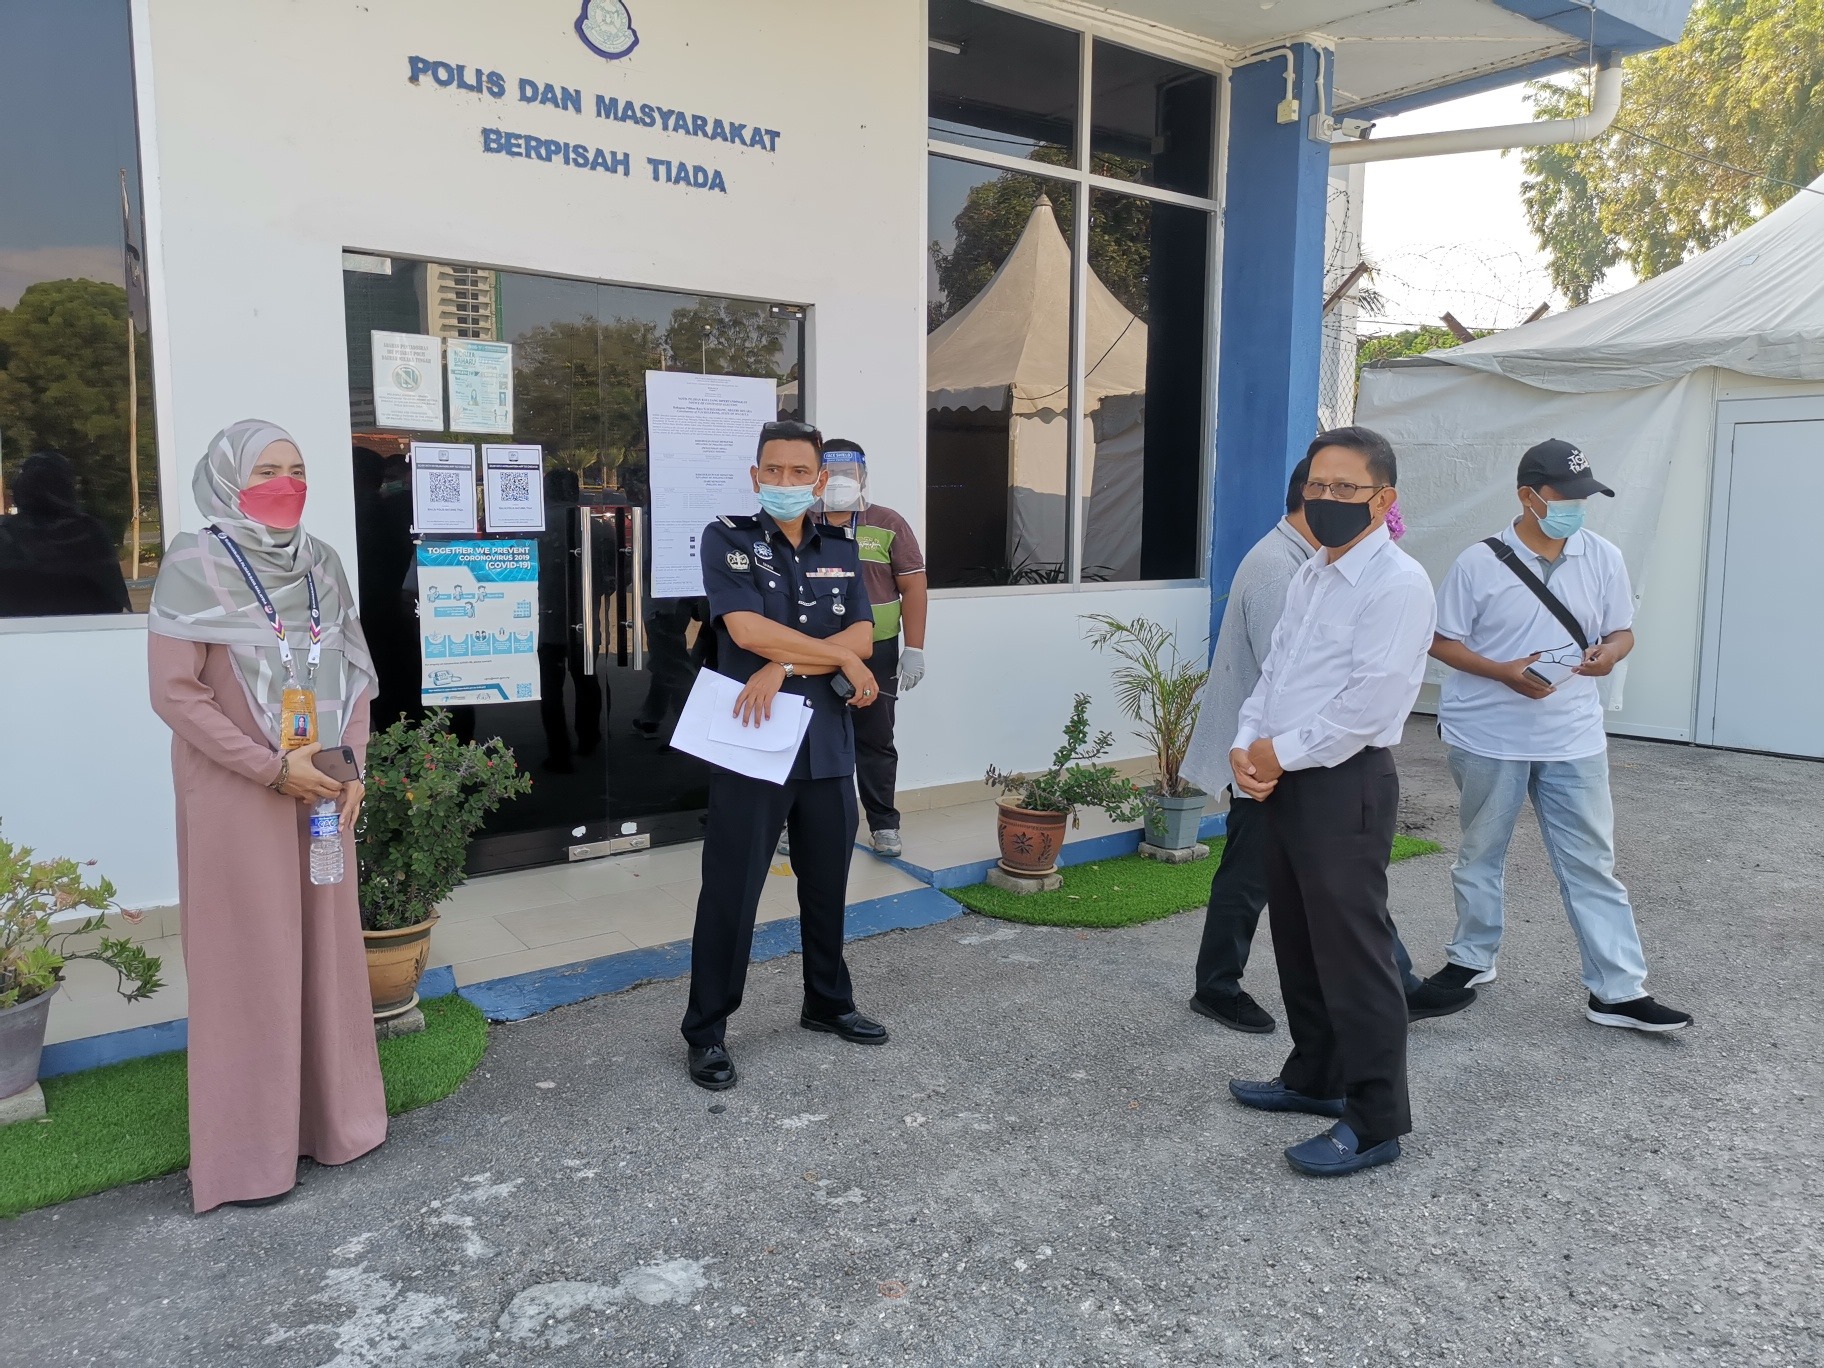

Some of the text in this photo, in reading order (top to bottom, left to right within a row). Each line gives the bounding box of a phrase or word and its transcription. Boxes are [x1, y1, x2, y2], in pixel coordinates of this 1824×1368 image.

[408, 55, 781, 151] POLIS DAN MASYARAKAT
[482, 127, 727, 194] BERPISAH TIADA
[485, 561, 531, 570] (COVID-19)
